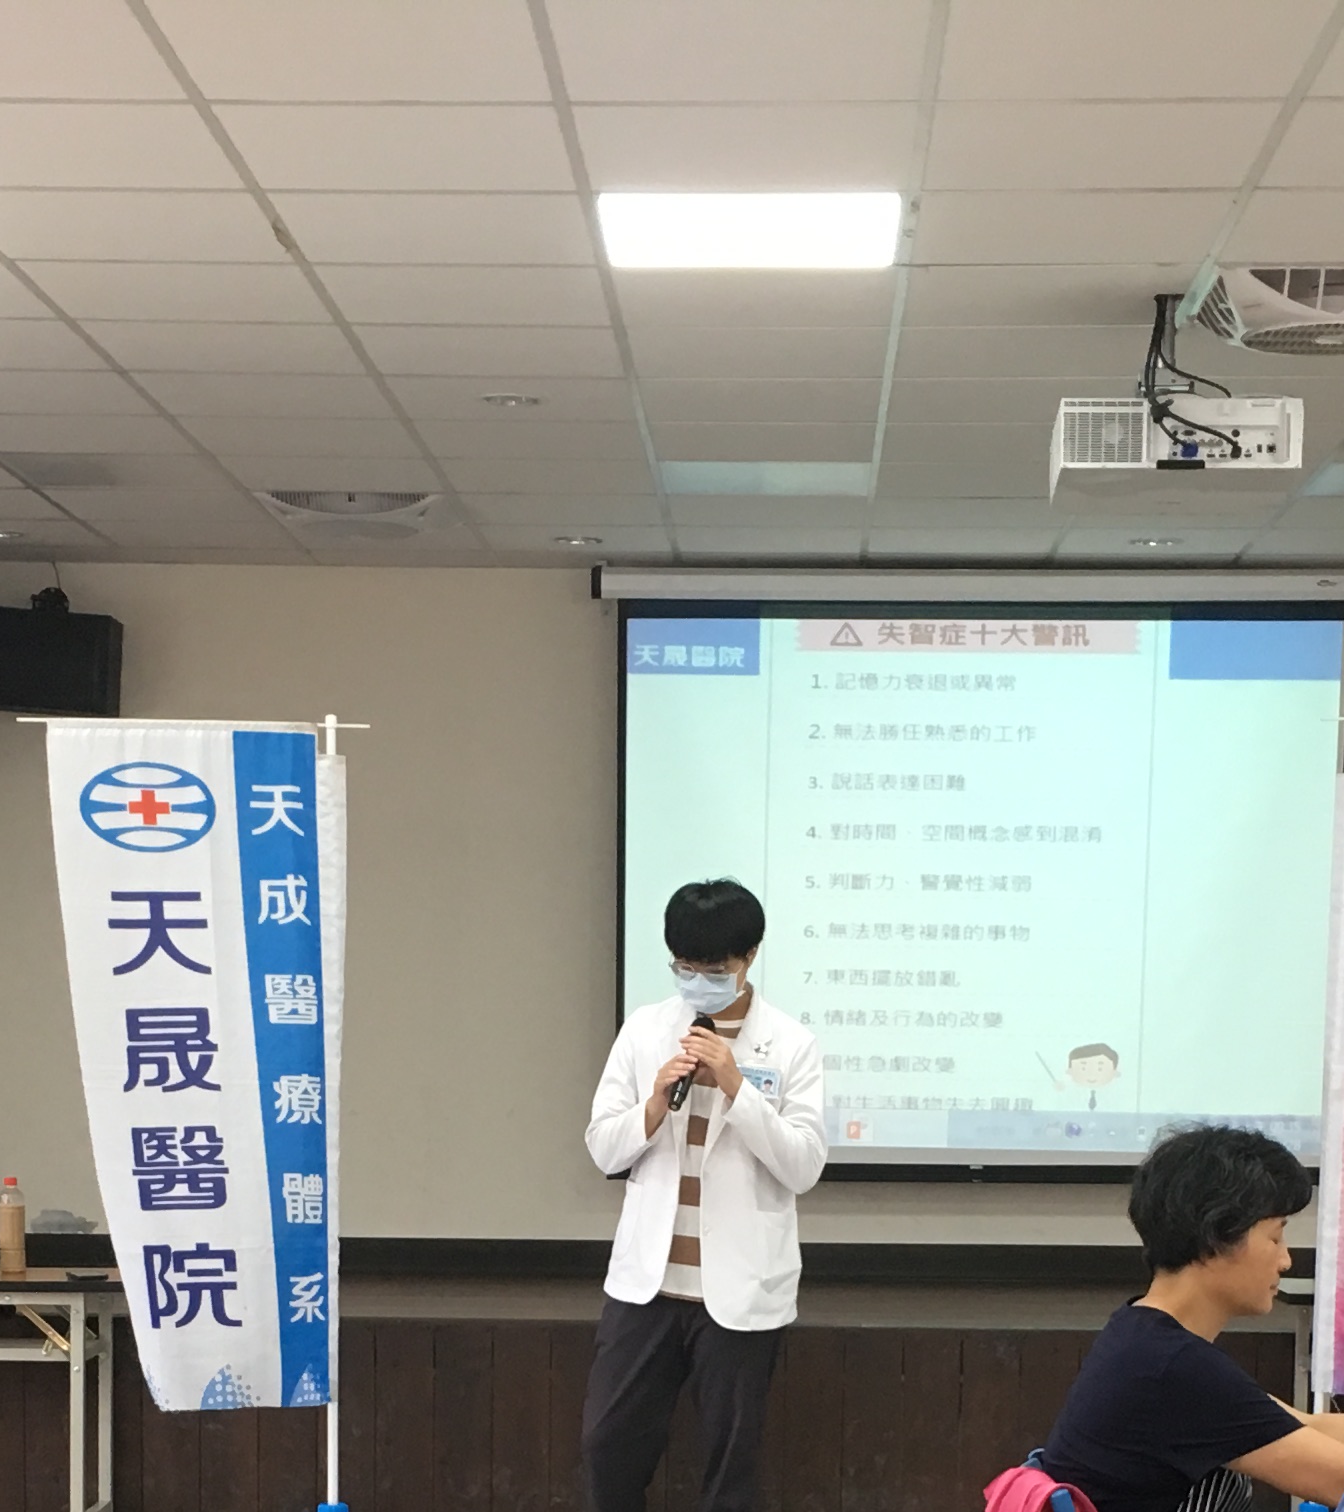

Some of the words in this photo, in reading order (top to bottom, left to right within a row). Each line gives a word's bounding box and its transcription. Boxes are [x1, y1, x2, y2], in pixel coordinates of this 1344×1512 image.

[877, 623, 1090, 647] 失智症十大警訊
[634, 644, 745, 668] 天晟醫院
[810, 674, 829, 690] 1.
[834, 672, 1017, 693] 記憶力衰退或異常
[807, 723, 827, 741] 2.
[832, 722, 1038, 743] 無法勝任熟悉的工作
[807, 776, 824, 791] 3.
[830, 772, 966, 792] 說話表達困難
[826, 922, 1031, 943] 無法思考複雜的事物
[823, 1009, 1004, 1030] 情緒及行為的改變
[250, 785, 325, 1322] 天成醫療體系
[108, 891, 242, 1329] 天晟醫院
